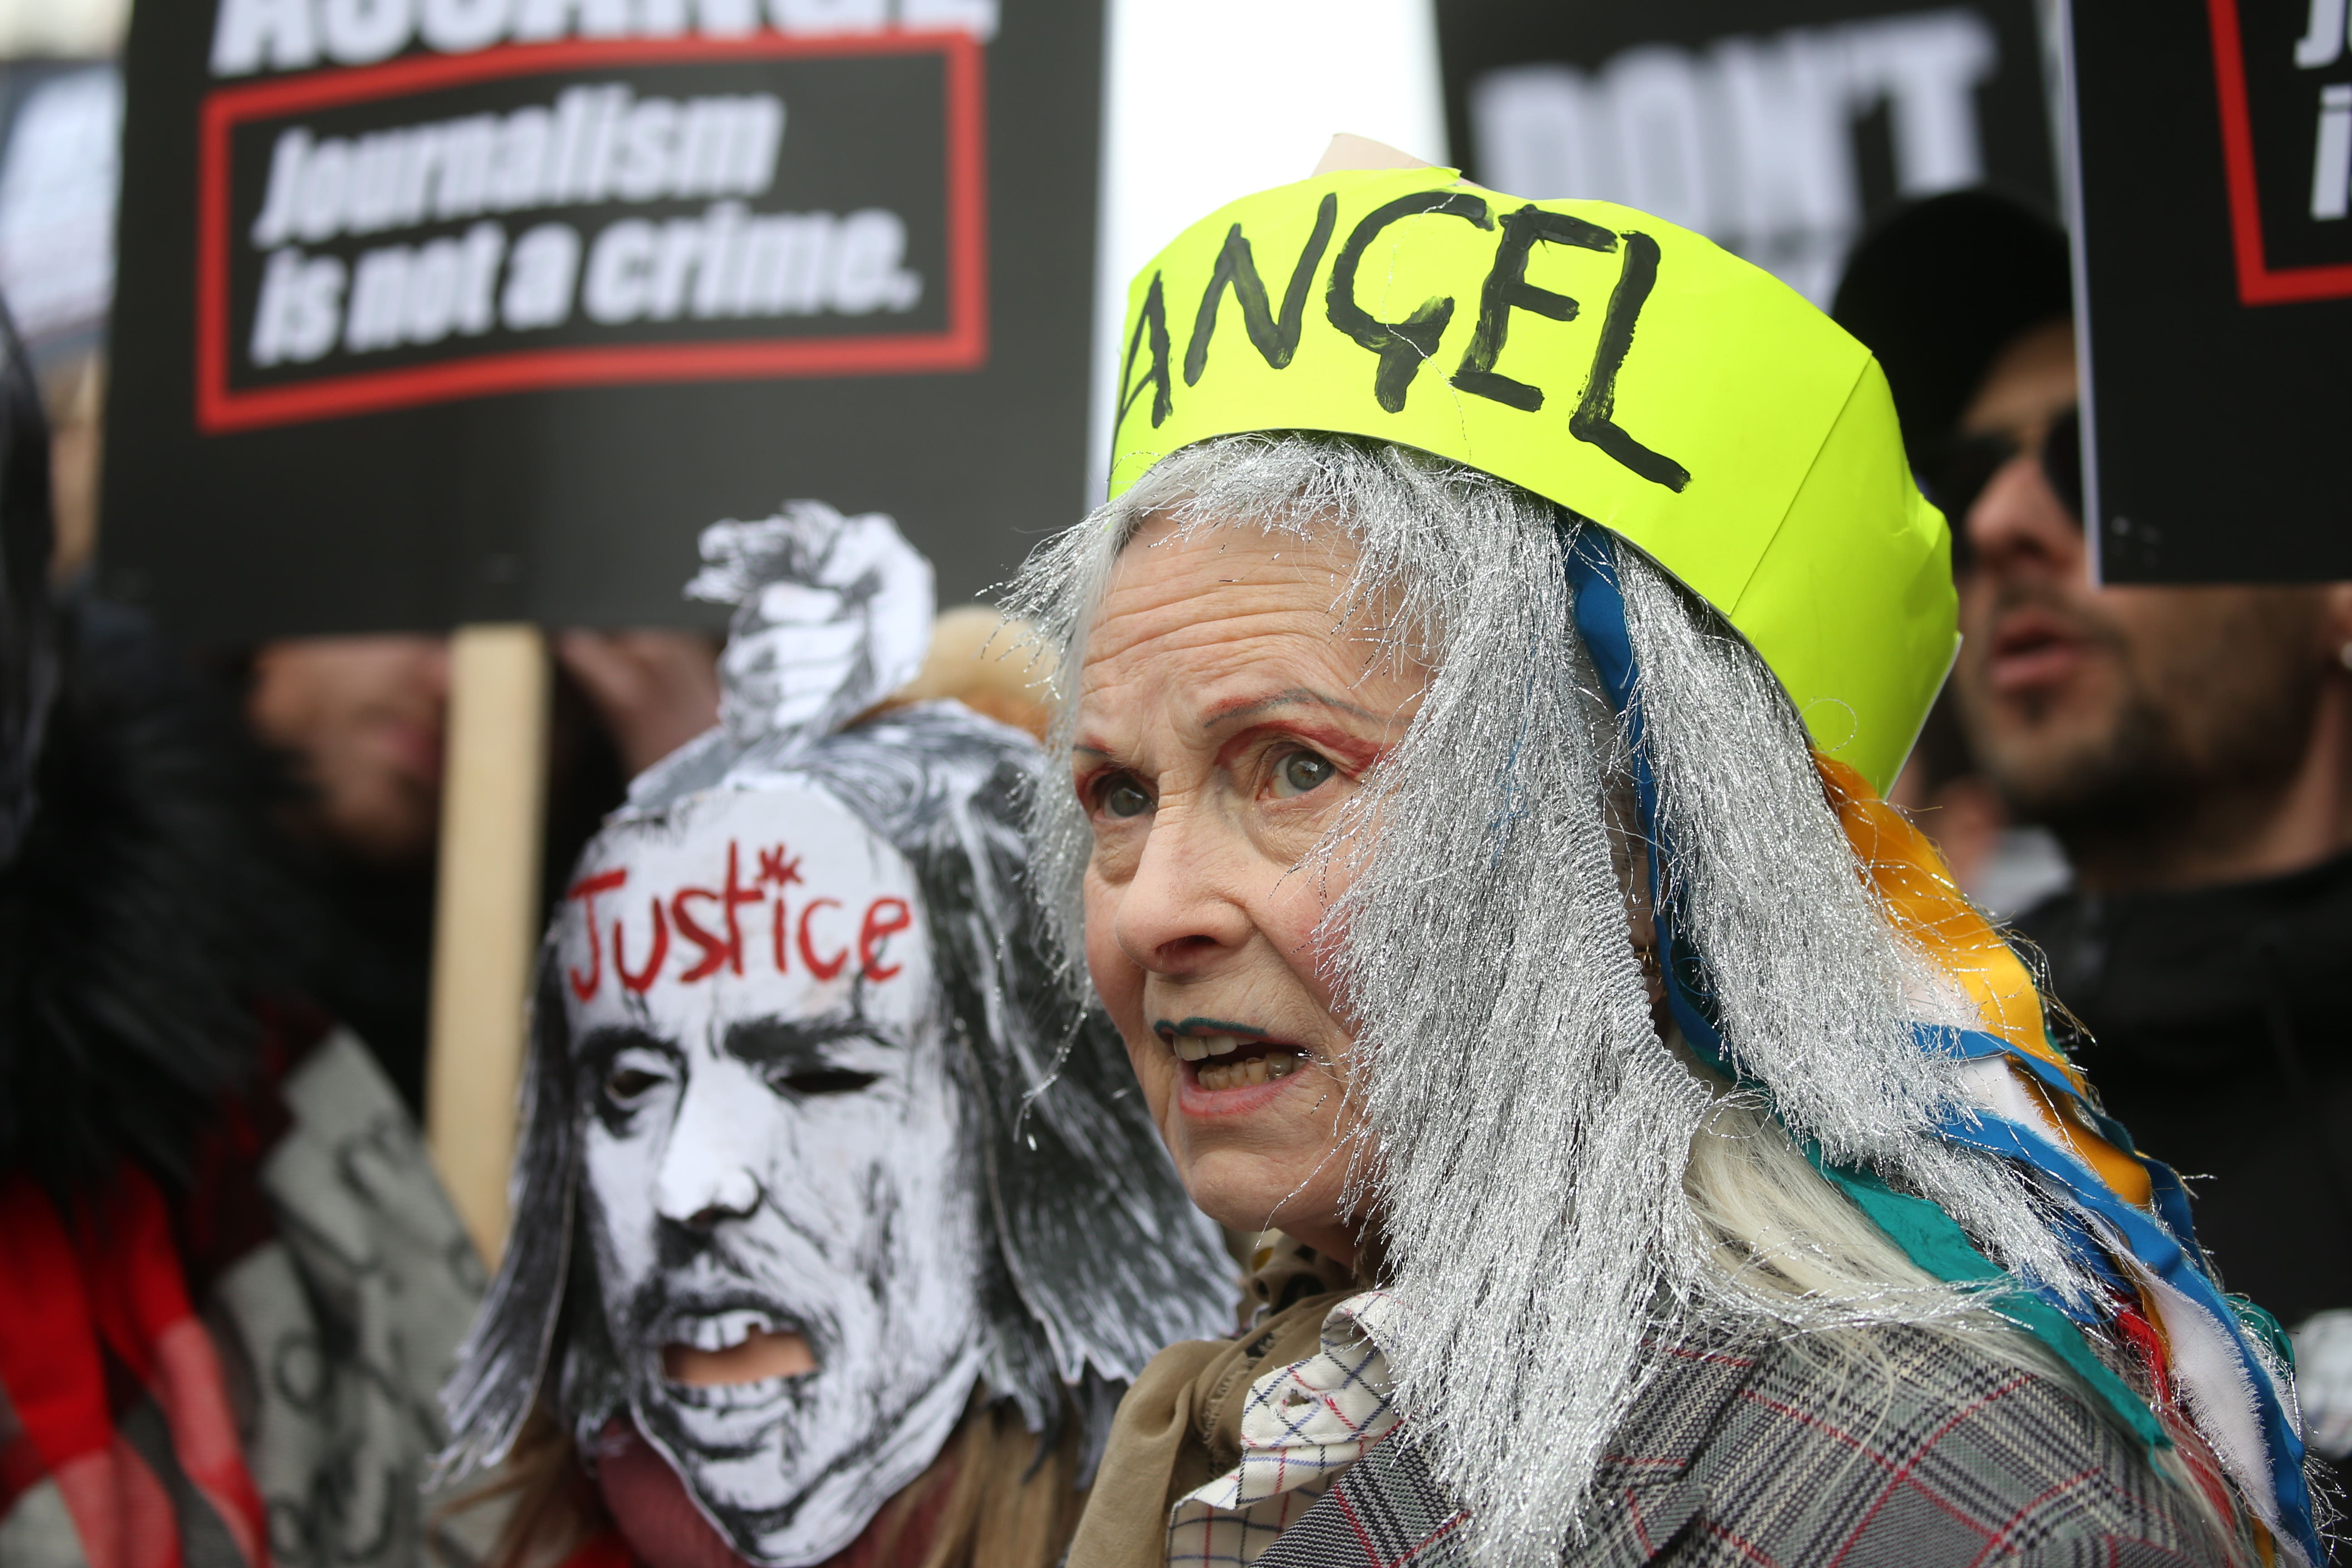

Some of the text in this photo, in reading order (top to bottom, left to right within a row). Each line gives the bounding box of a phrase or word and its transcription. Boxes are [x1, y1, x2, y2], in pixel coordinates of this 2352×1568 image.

[251, 83, 786, 247] Journalism
[250, 201, 924, 366] is not a crime.
[1114, 190, 1693, 494] ANGEL
[568, 839, 912, 1004] Justice
